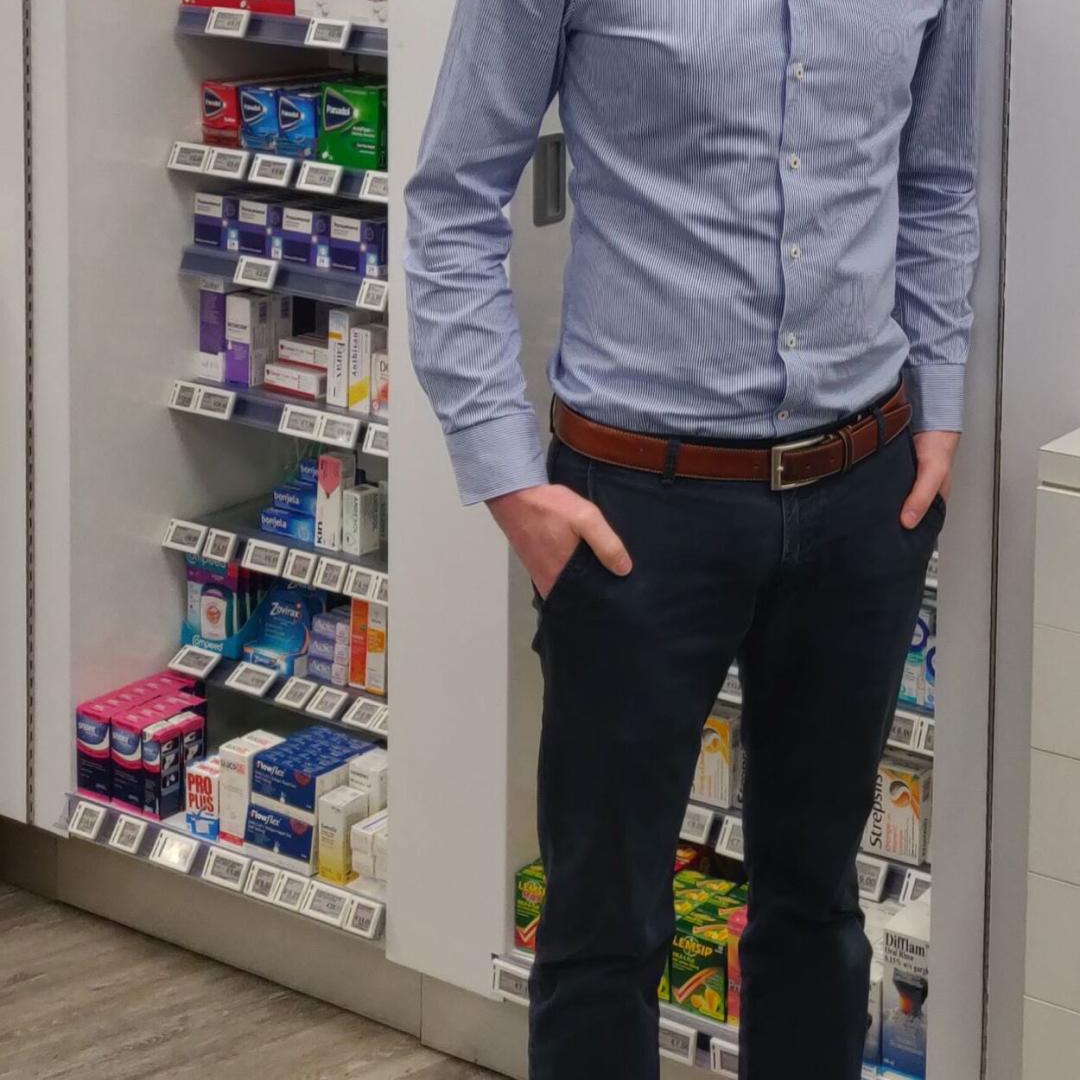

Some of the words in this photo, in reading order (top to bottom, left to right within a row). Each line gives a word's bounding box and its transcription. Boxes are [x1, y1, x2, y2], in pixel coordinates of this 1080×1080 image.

[269, 601, 301, 619] Zovirax
[187, 771, 213, 792] PRO
[187, 788, 215, 813] PLUS
[671, 934, 714, 958] LEMSIP
[885, 931, 927, 959] Difflam
